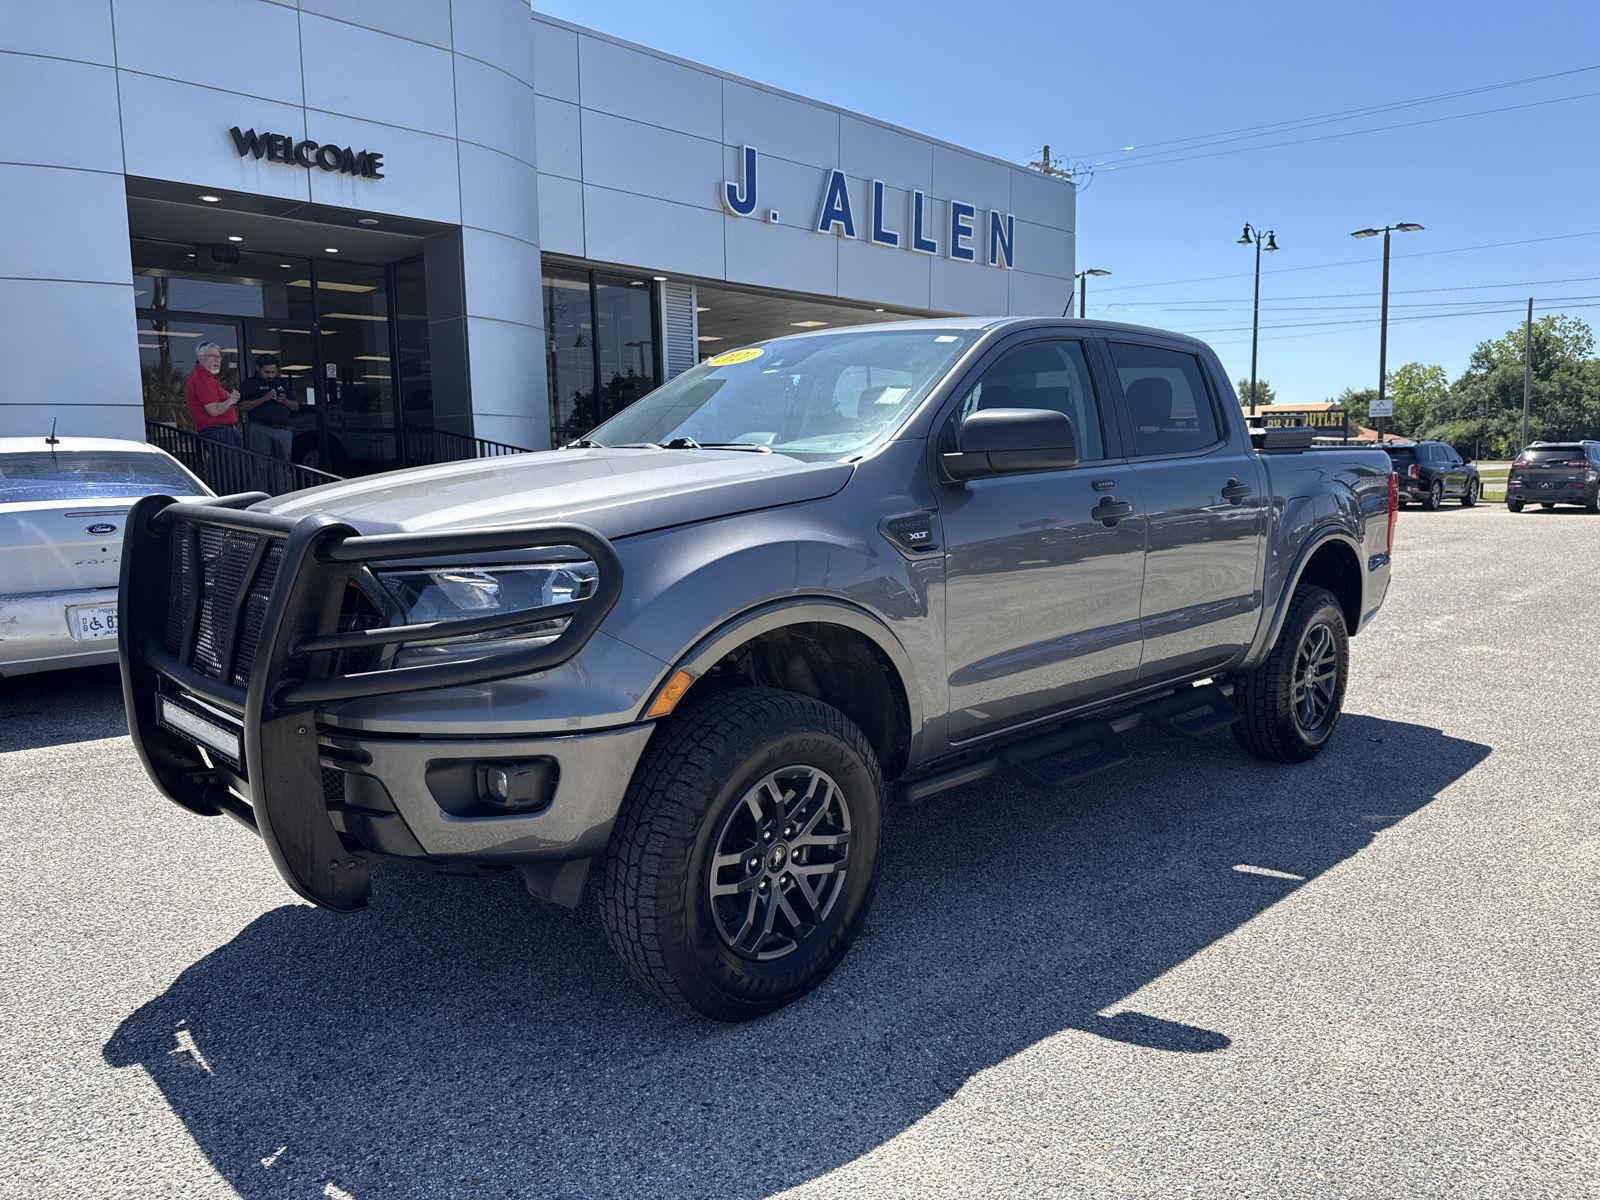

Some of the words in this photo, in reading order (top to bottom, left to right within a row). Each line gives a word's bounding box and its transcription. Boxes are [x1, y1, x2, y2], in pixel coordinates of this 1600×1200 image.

[229, 126, 385, 179] WELCOME
[721, 144, 779, 223] J.
[814, 168, 1016, 270] ALLEN
[908, 531, 928, 540] XLT
